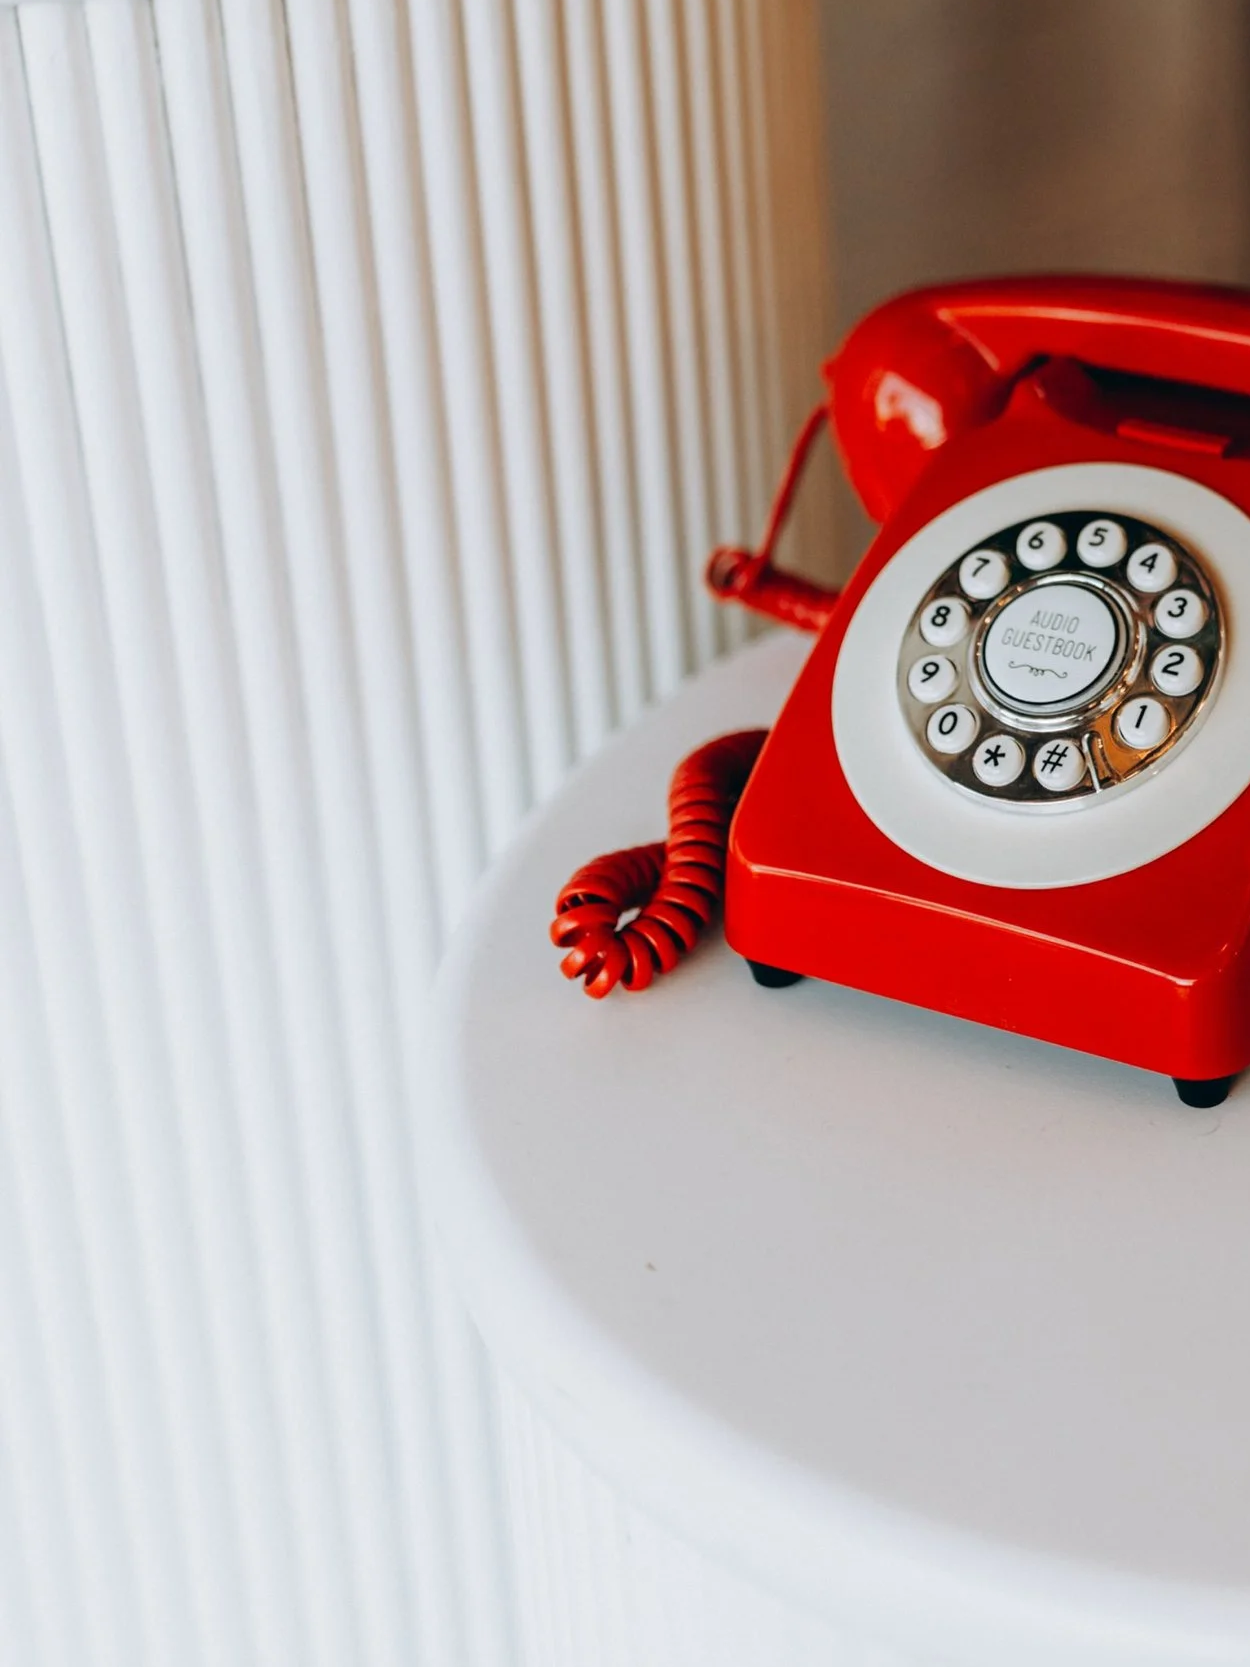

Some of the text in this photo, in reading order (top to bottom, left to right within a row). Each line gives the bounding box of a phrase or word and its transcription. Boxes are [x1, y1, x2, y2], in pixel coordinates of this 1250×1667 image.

[1027, 531, 1045, 549] 6
[1089, 527, 1109, 547] 5
[970, 558, 990, 577] 7
[1140, 553, 1158, 574] 4
[931, 606, 951, 627] 8
[1167, 597, 1187, 618] 3
[1030, 610, 1080, 633] AUDIO
[1001, 631, 1097, 662] GUESTBOOK
[920, 662, 940, 683] 9
[1161, 652, 1185, 676] 2
[938, 711, 958, 734] 0
[1134, 705, 1148, 728] 1
